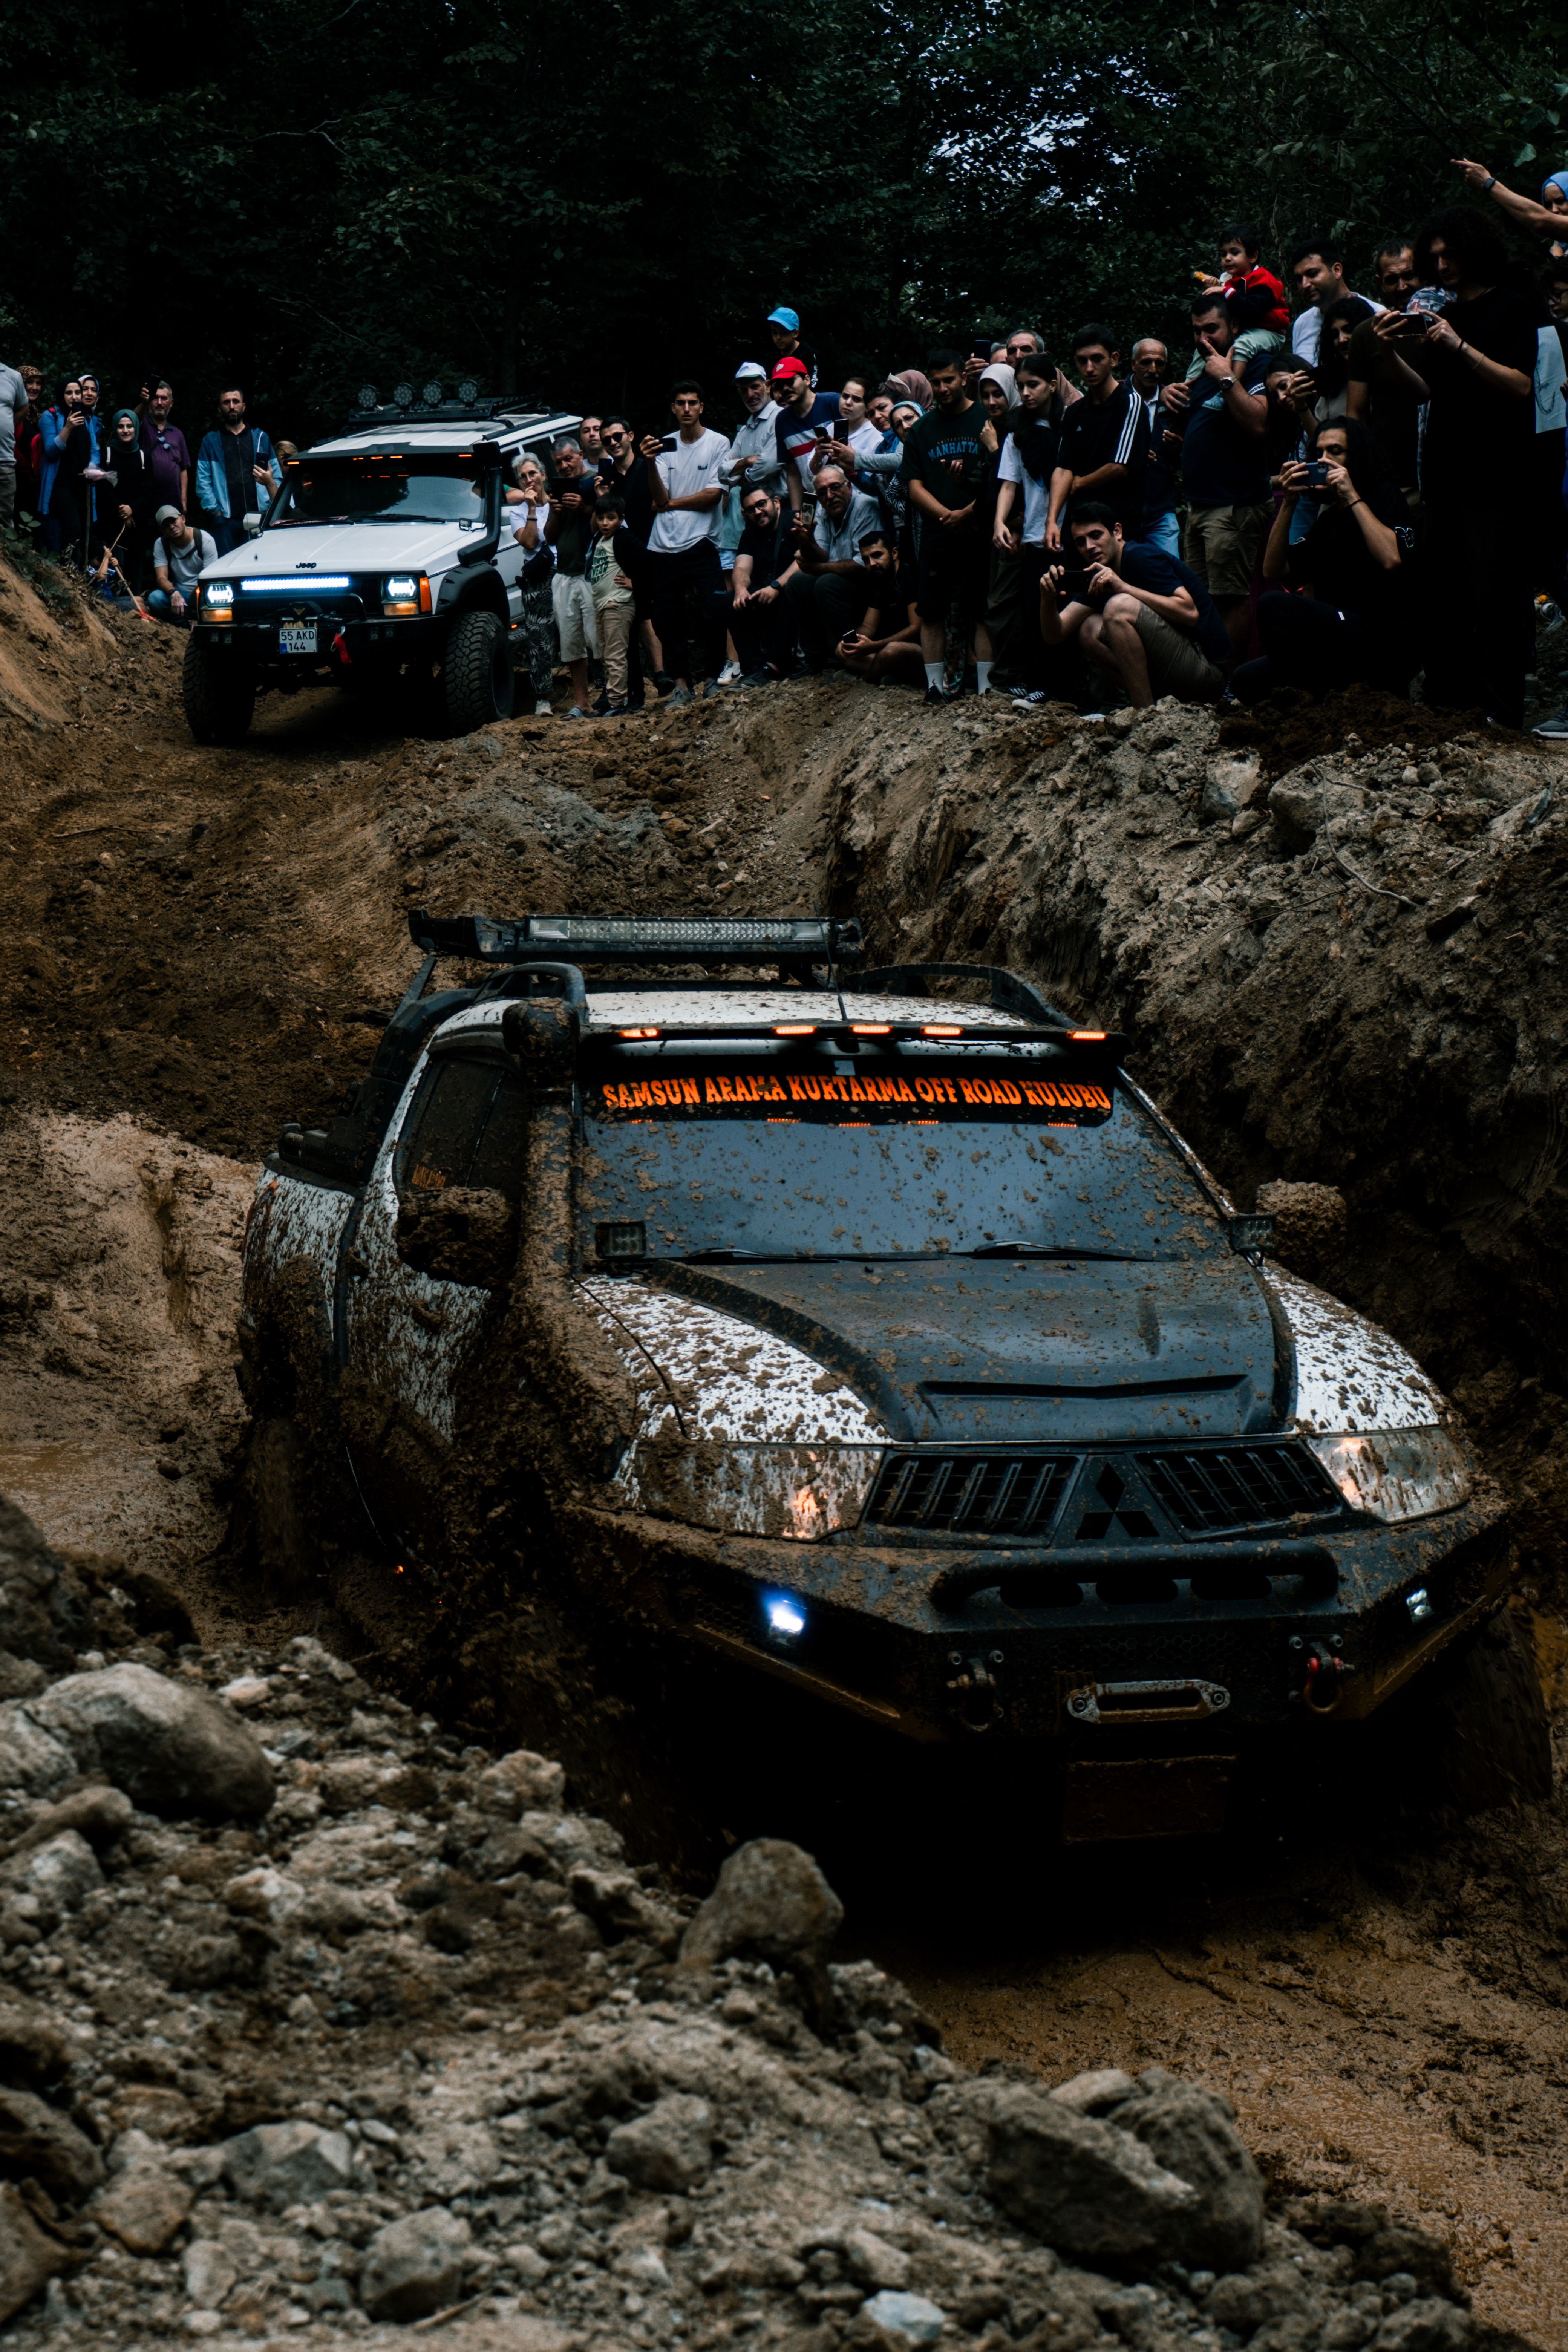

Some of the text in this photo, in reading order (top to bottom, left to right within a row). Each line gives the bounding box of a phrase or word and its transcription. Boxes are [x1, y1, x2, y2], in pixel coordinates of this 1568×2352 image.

[928, 441, 978, 461] MANHATTA
[281, 631, 314, 640] 55 AKD
[289, 642, 306, 651] 144
[603, 1075, 1111, 1109] SAMSUN ARAMA KURTARMA OFF ROAD KULÜBÜ
